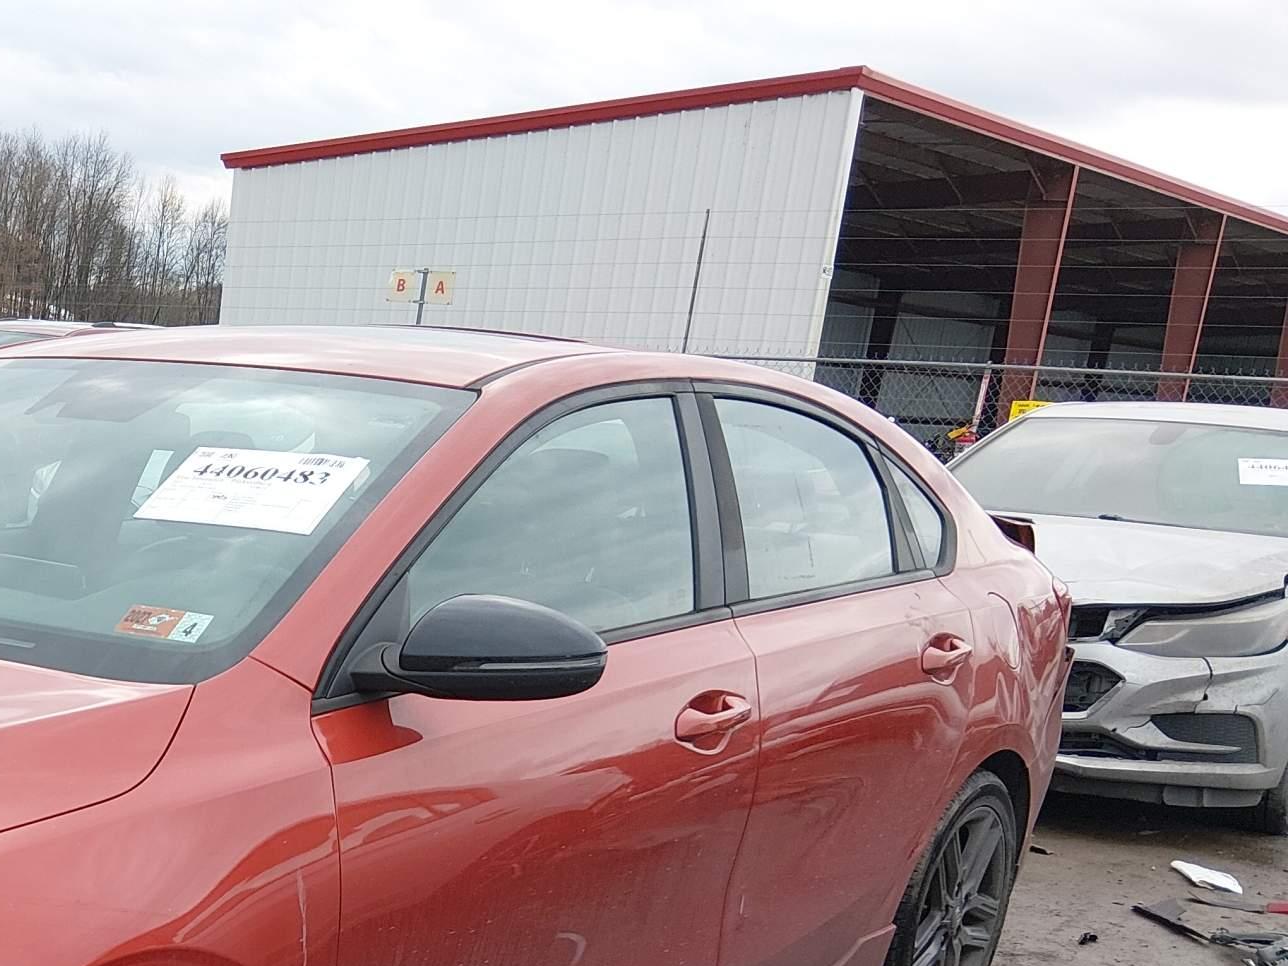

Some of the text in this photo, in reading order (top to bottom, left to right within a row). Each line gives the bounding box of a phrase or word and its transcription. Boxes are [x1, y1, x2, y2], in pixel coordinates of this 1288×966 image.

[396, 278, 406, 292] B
[434, 281, 445, 294] A
[193, 463, 331, 486] 44060483
[182, 622, 198, 637] 4
